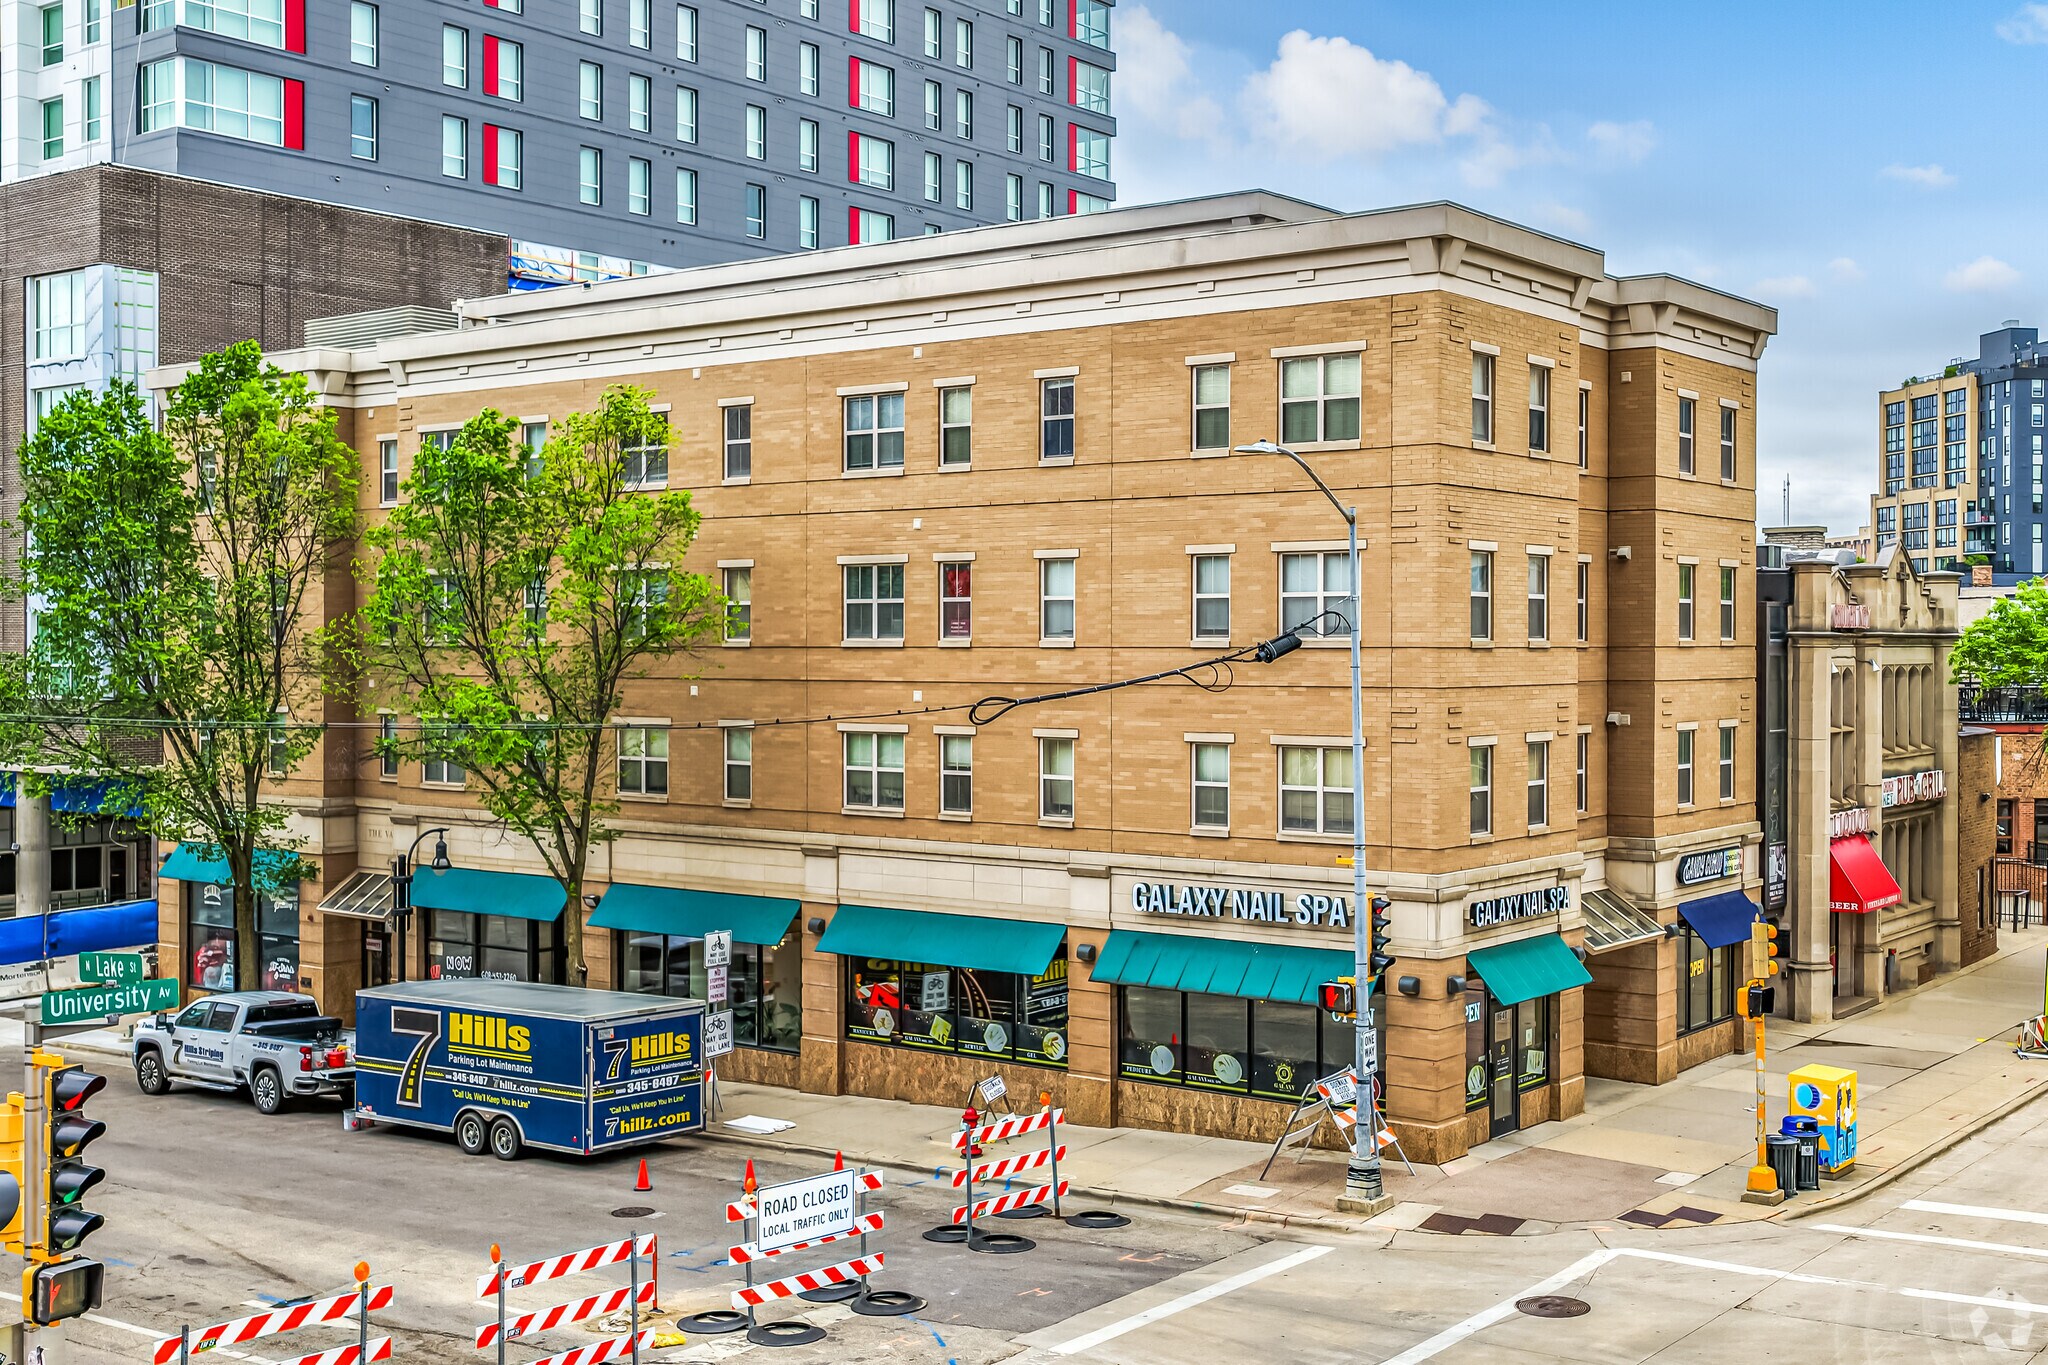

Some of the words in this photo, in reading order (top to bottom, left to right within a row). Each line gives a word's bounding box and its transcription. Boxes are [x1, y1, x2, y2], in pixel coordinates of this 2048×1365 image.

[1896, 775, 1916, 805] PUB
[1921, 770, 1948, 801] GRILL
[1132, 882, 1229, 917] GALAXY
[1231, 890, 1292, 924] NAIL
[1295, 894, 1350, 928] SPA
[1475, 894, 1521, 927] GALAXY
[1523, 889, 1548, 917] NAIL
[1549, 886, 1570, 912] SPA
[1830, 902, 1859, 910] BEER
[85, 959, 91, 972] N
[95, 955, 124, 978] Lake
[129, 961, 137, 973] St
[446, 956, 473, 971] NOW
[1690, 958, 1705, 978] OPEN
[50, 985, 151, 1018] University
[158, 986, 171, 999] Av
[706, 1035, 716, 1043] MAY
[718, 1032, 728, 1041] USE
[1364, 1033, 1375, 1047] ONE
[184, 1044, 198, 1055] Hills
[198, 1046, 224, 1060] Striping
[706, 1045, 716, 1054] ULL
[718, 1041, 731, 1051] LANE
[1364, 1047, 1376, 1058] WAY
[391, 1005, 442, 1108] 7
[449, 1012, 531, 1052] Hills
[448, 1053, 475, 1068] Parking
[476, 1057, 488, 1067] Lot
[489, 1059, 533, 1074] Maintenance
[603, 1038, 629, 1080] 7
[631, 1032, 691, 1061] Hills
[630, 1066, 651, 1076] Parking
[651, 1064, 661, 1072] Lot
[661, 1060, 693, 1071] Maintenance
[984, 1079, 1002, 1093] SIDEWALK
[1329, 1078, 1349, 1090] SIDEWALK
[1335, 1085, 1350, 1095] CLOSED
[989, 1087, 1004, 1098] CLOSED
[500, 1097, 511, 1106] You
[658, 1098, 667, 1106] You
[764, 1195, 798, 1217] ROAD
[803, 1184, 849, 1208] CLOSED
[763, 1222, 790, 1238] LOCAL
[793, 1213, 826, 1231] TRAFFIC
[828, 1208, 850, 1222] ONLY
